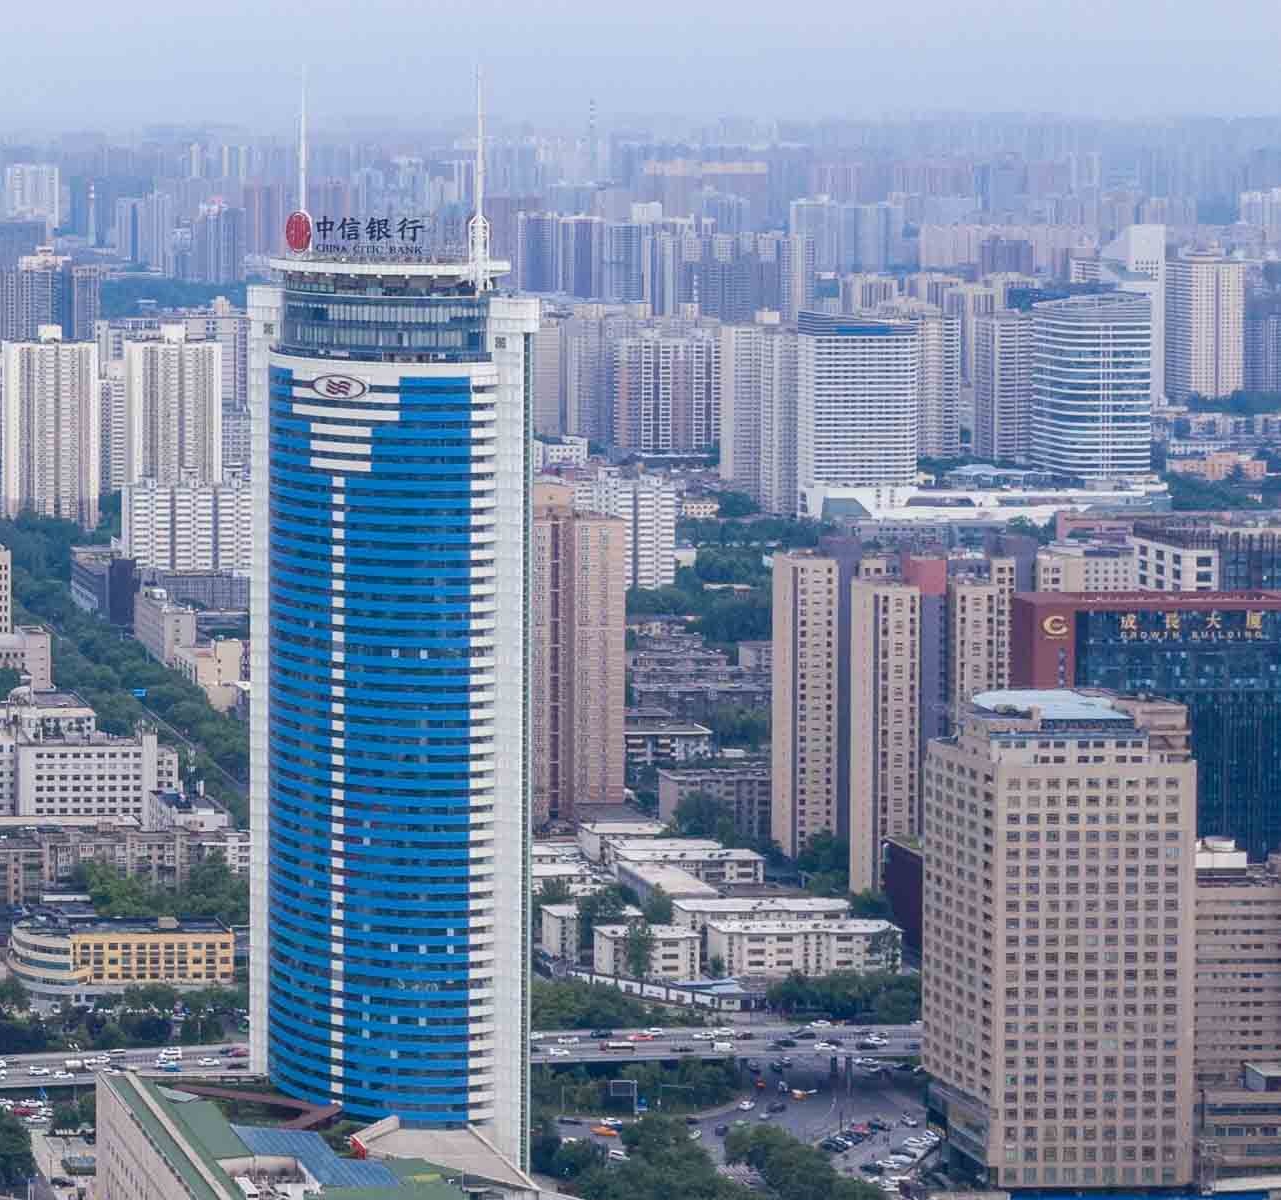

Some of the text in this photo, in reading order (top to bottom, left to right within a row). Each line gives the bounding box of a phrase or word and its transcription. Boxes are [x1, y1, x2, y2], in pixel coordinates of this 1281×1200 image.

[315, 215, 425, 242] 中信银行
[315, 243, 423, 256] CHINA CITIC BANK
[1190, 631, 1265, 641] BUILDING
